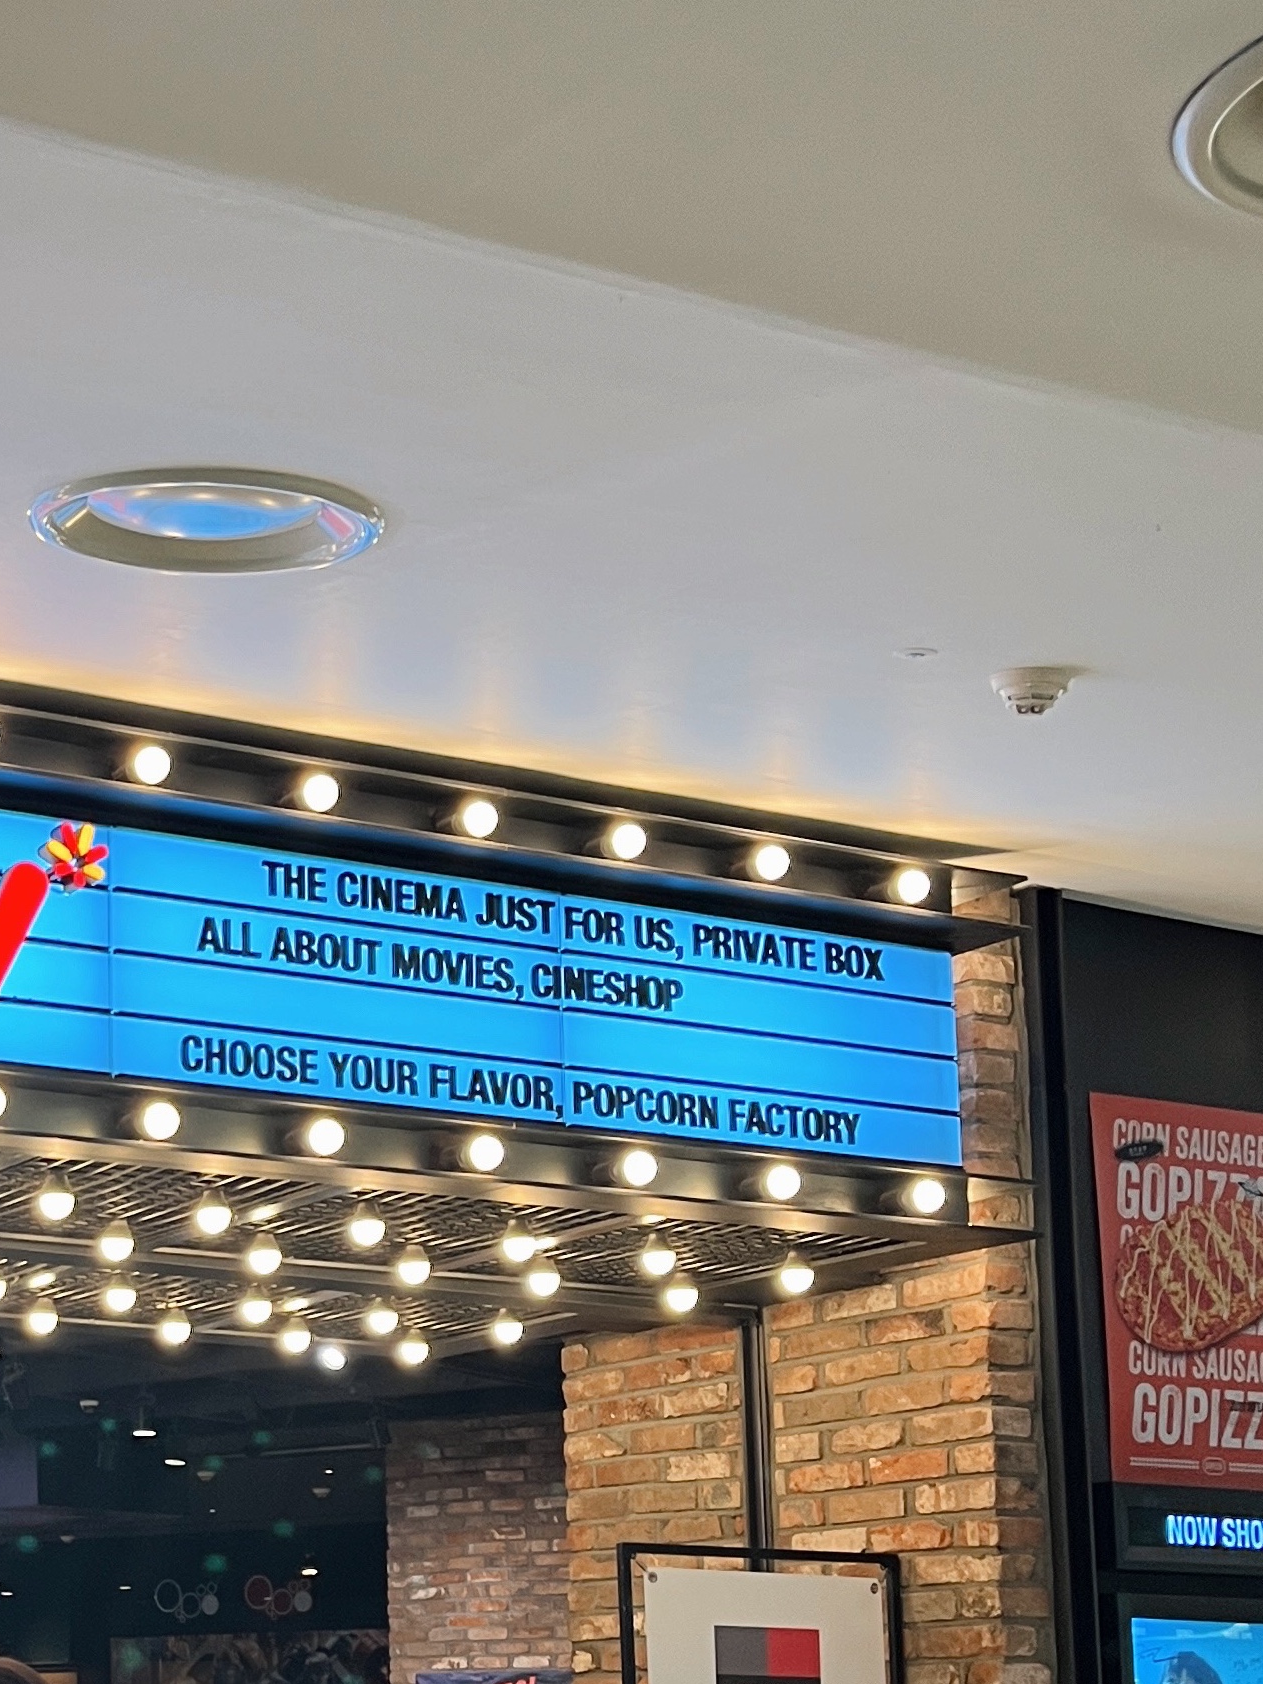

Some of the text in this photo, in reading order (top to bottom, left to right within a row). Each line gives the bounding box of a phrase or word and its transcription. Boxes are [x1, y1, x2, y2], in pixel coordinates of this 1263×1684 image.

[197, 916, 685, 1013] ALL ABOUT MOVIES, CINESHOP
[262, 859, 886, 983] THE CINEMA JUST FOR US, PRIVATE BOX
[179, 1032, 861, 1147] CHOOSE YOUR FLAVOR, POPCORN FACTORY
[1128, 1340, 1263, 1384] CORN SAUSA
[1165, 1514, 1218, 1547] NOW
